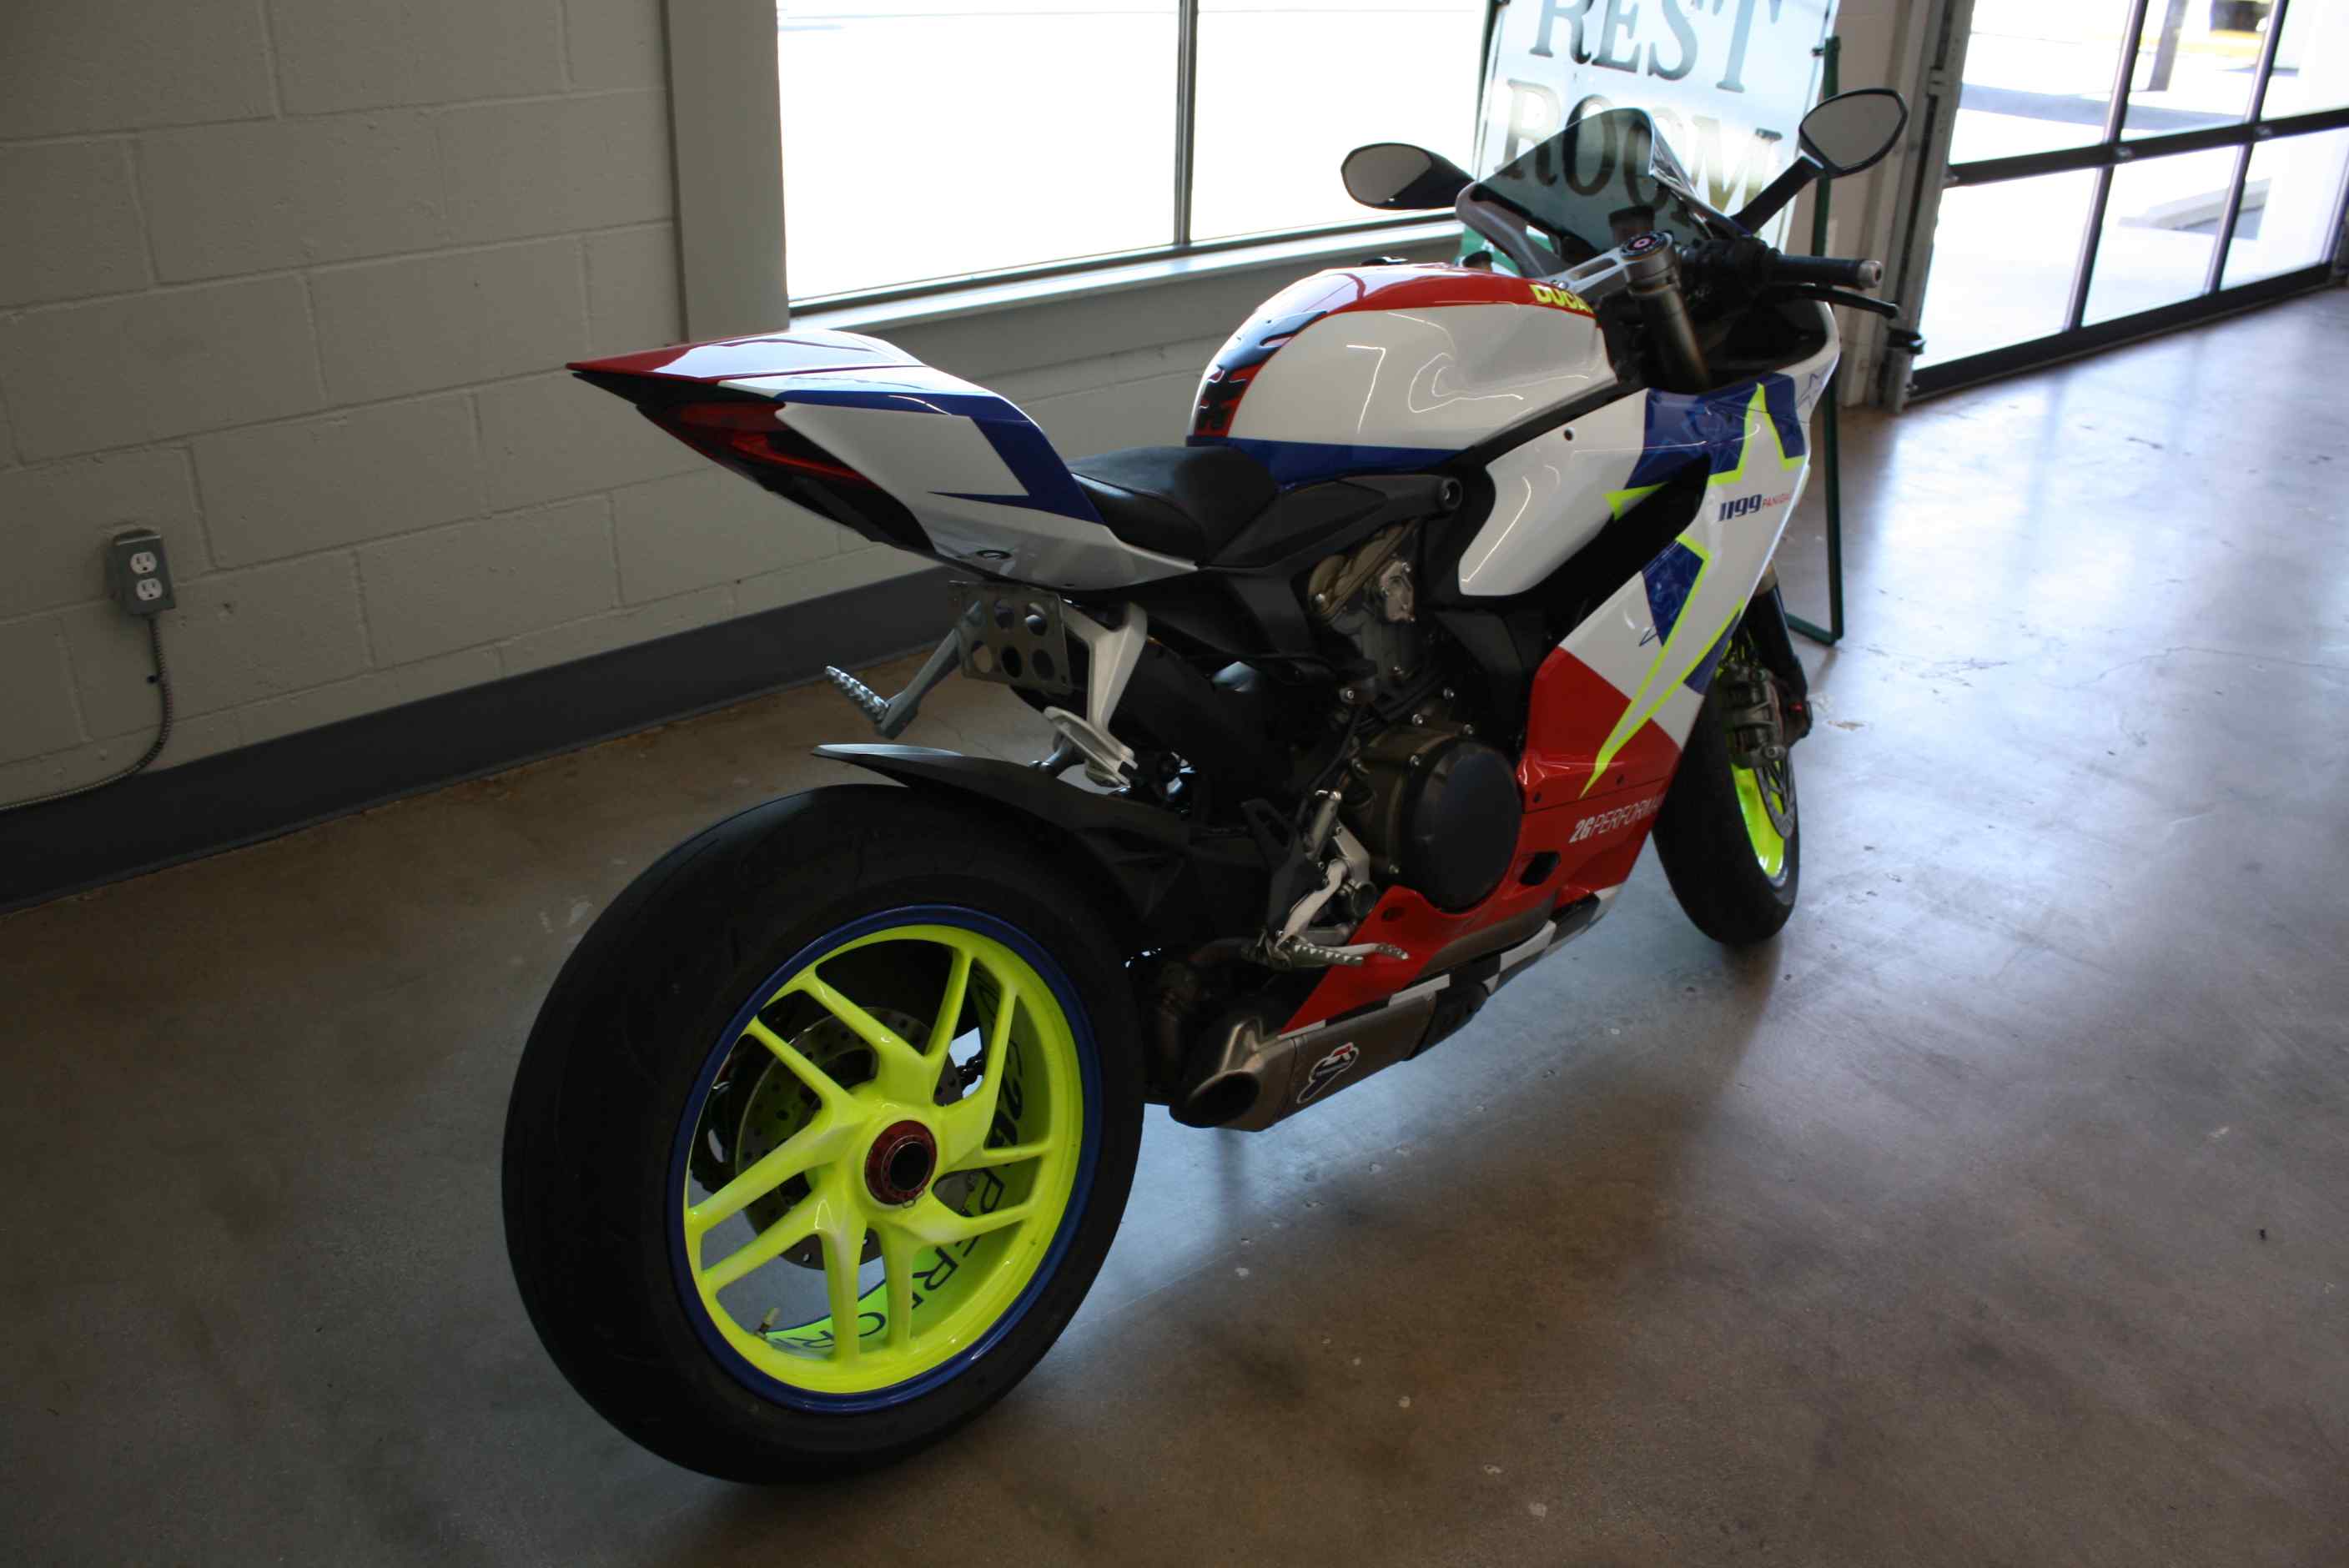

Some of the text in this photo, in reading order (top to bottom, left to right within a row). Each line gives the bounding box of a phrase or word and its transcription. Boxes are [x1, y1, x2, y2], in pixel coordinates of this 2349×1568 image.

[1529, 0, 1783, 93] REST
[1527, 283, 1594, 314] DUCA
[1718, 493, 1763, 522] 1199
